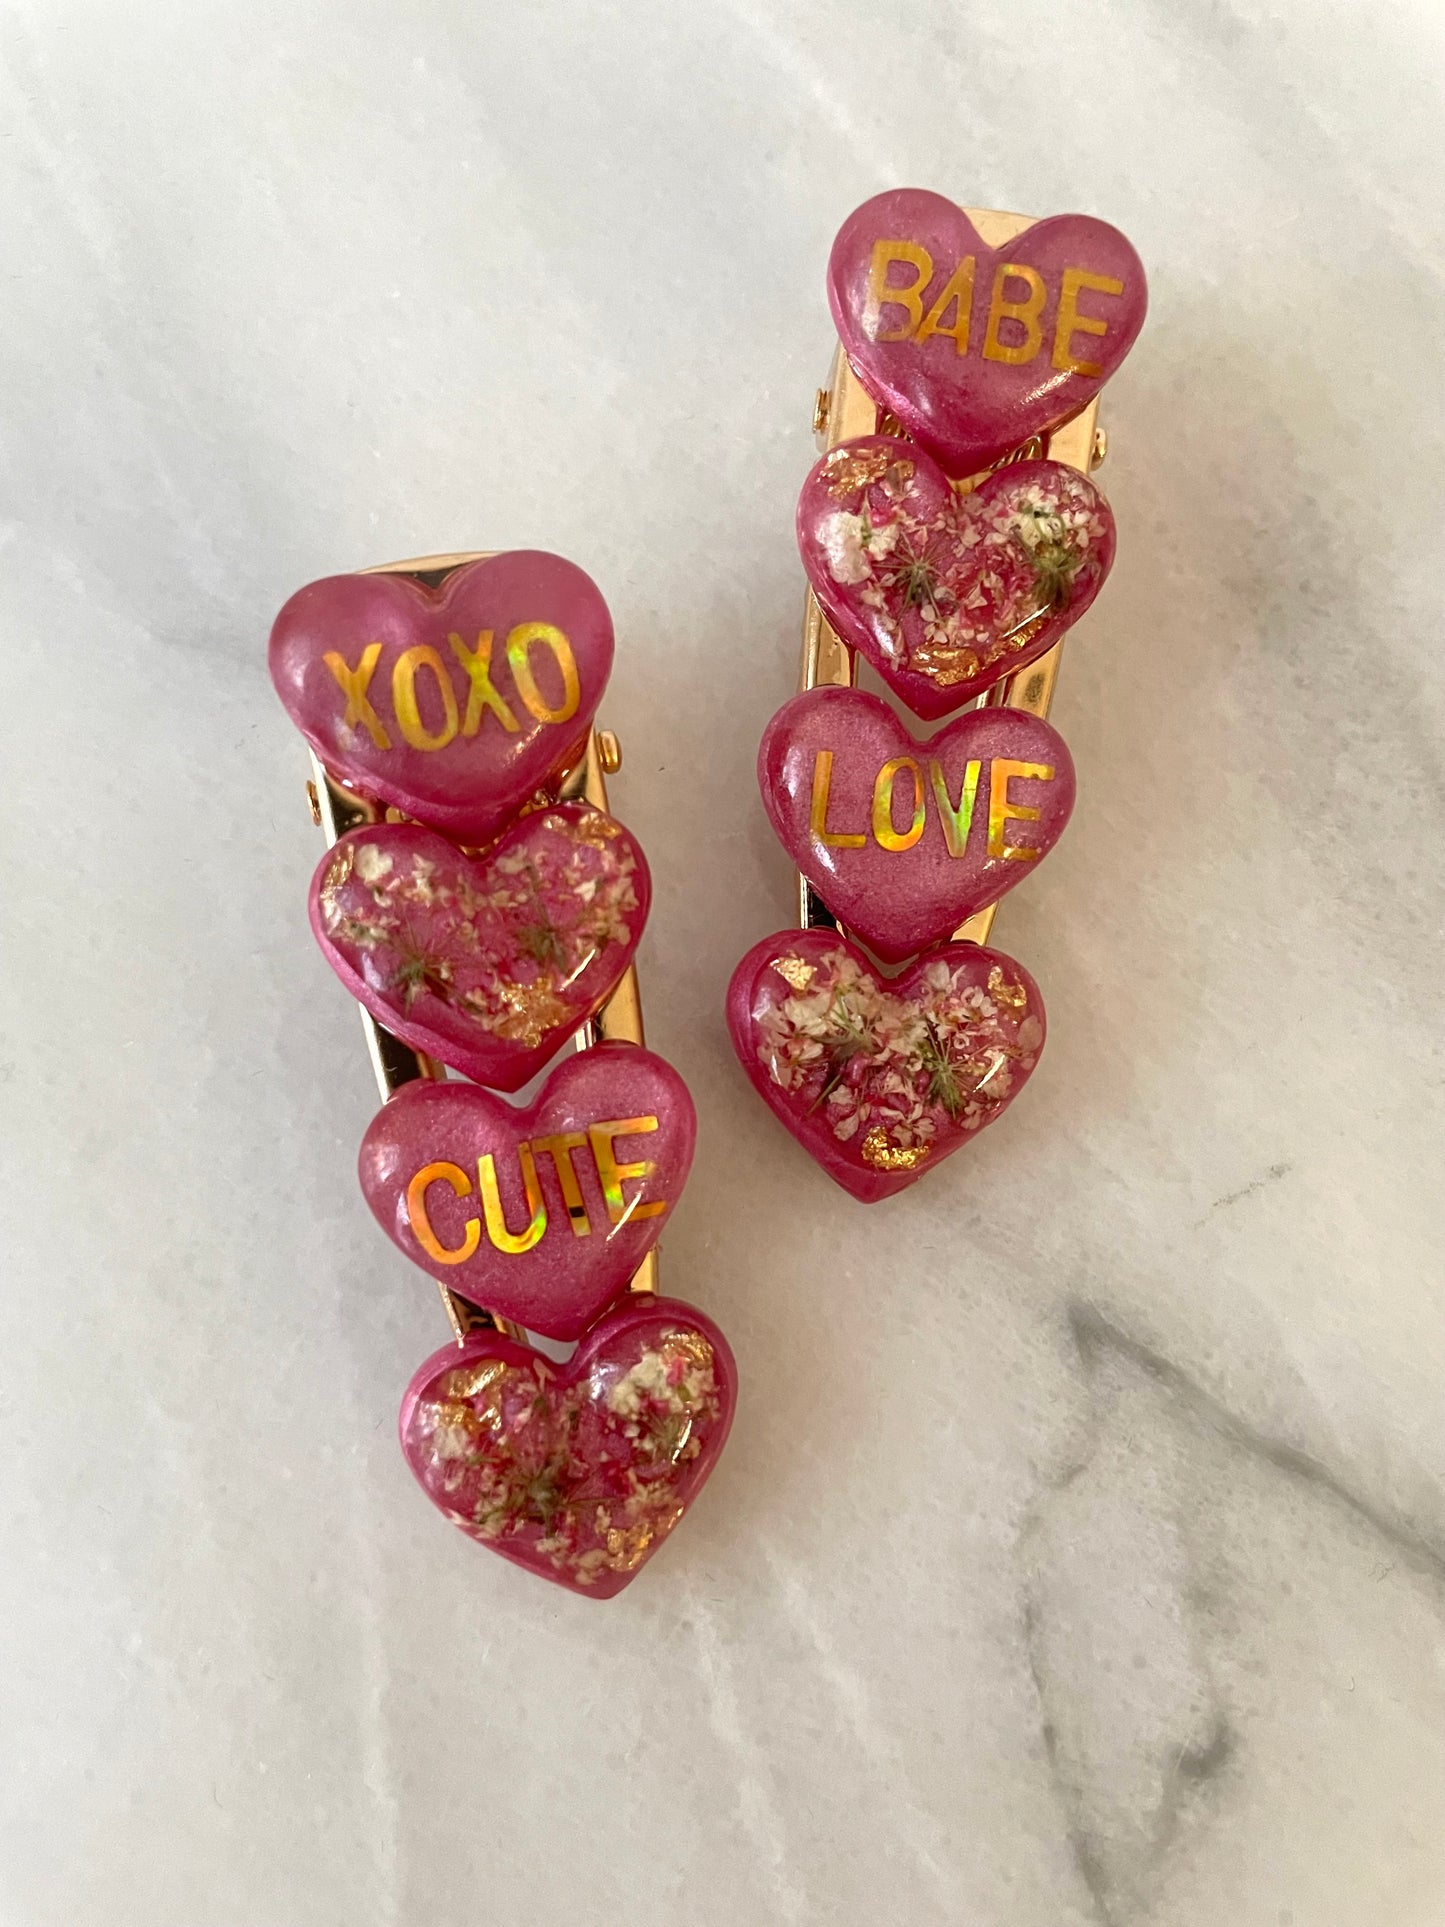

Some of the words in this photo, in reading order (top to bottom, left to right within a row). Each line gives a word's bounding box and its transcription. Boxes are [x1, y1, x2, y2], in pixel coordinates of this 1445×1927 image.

[862, 240, 1123, 378] BABE
[322, 621, 581, 752] XOXO
[810, 751, 1055, 861] LOVE
[407, 1115, 667, 1265] CUTE
